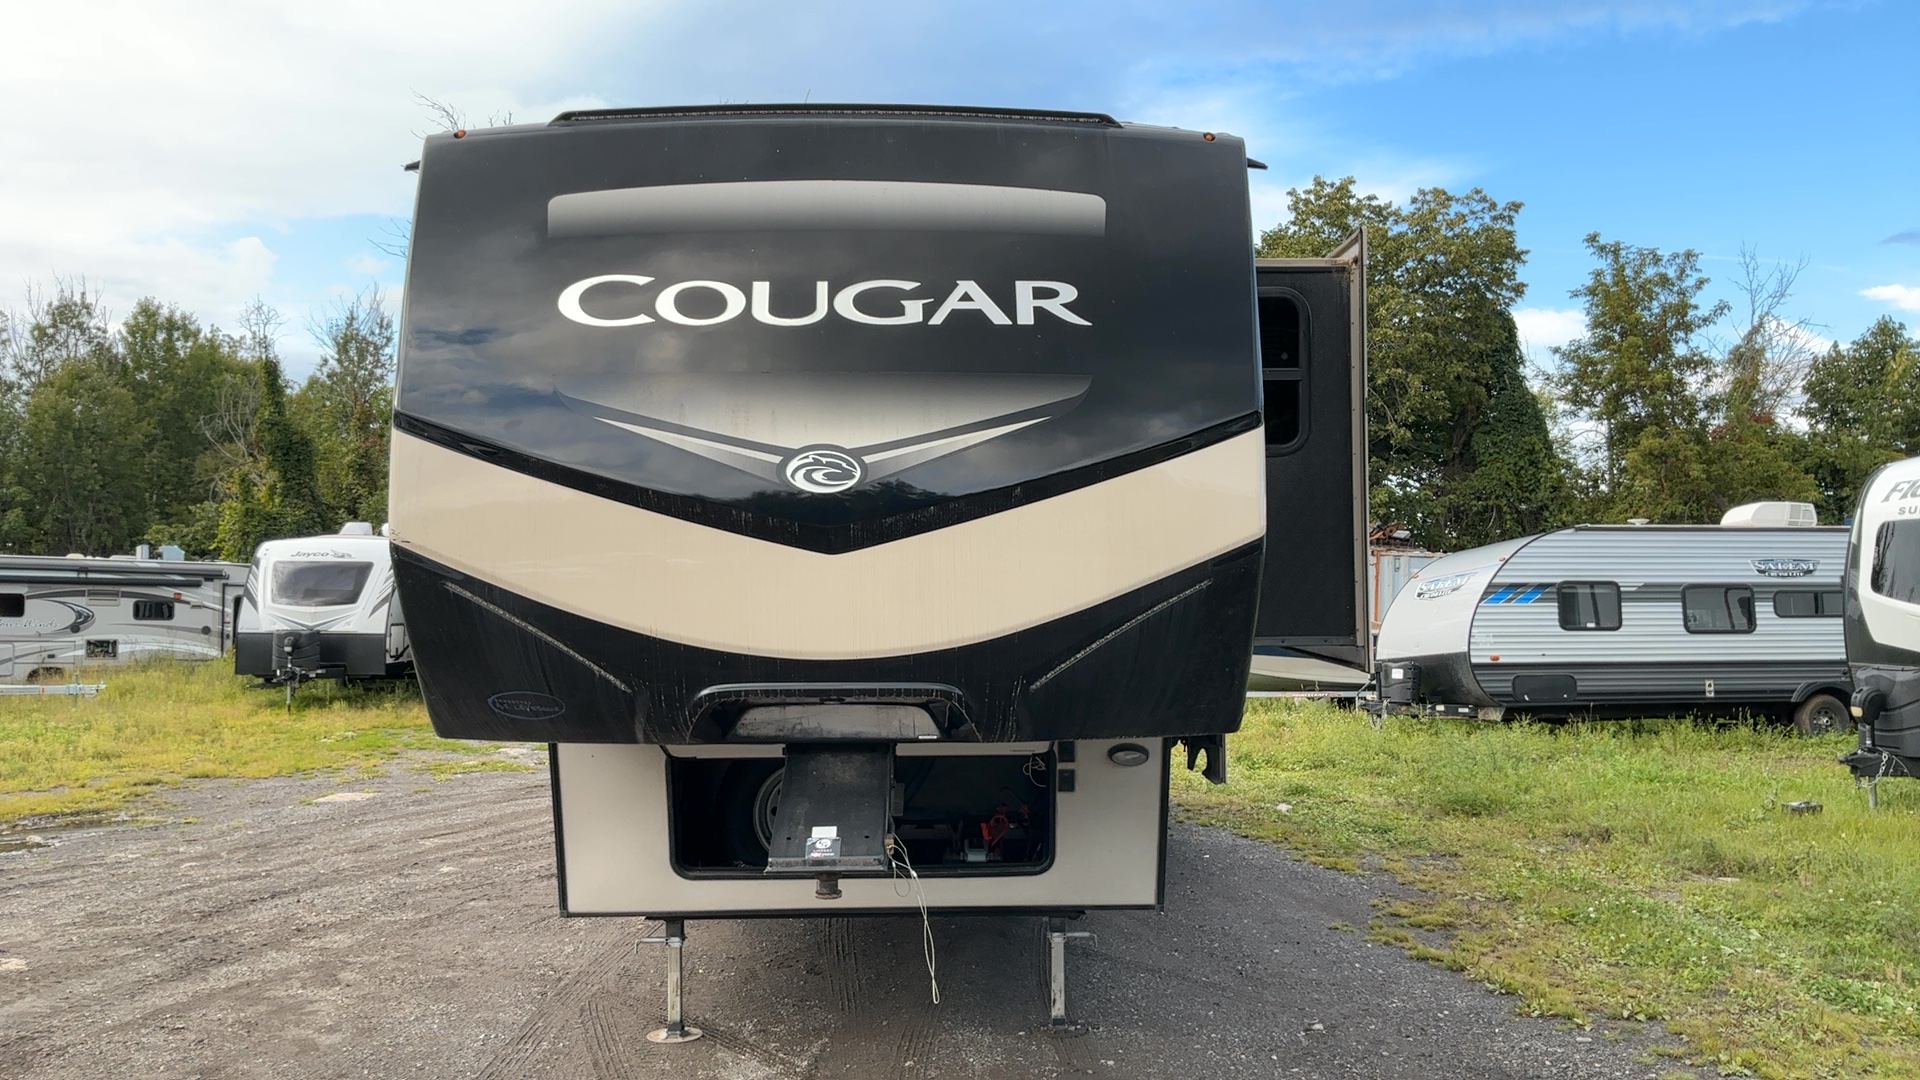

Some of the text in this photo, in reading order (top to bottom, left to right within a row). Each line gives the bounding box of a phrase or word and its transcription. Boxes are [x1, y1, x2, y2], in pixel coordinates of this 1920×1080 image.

[557, 274, 1093, 327] COUGAR
[1898, 505, 1920, 516] SU
[1754, 562, 1815, 570] SALEM
[1420, 576, 1470, 592] SALEM
